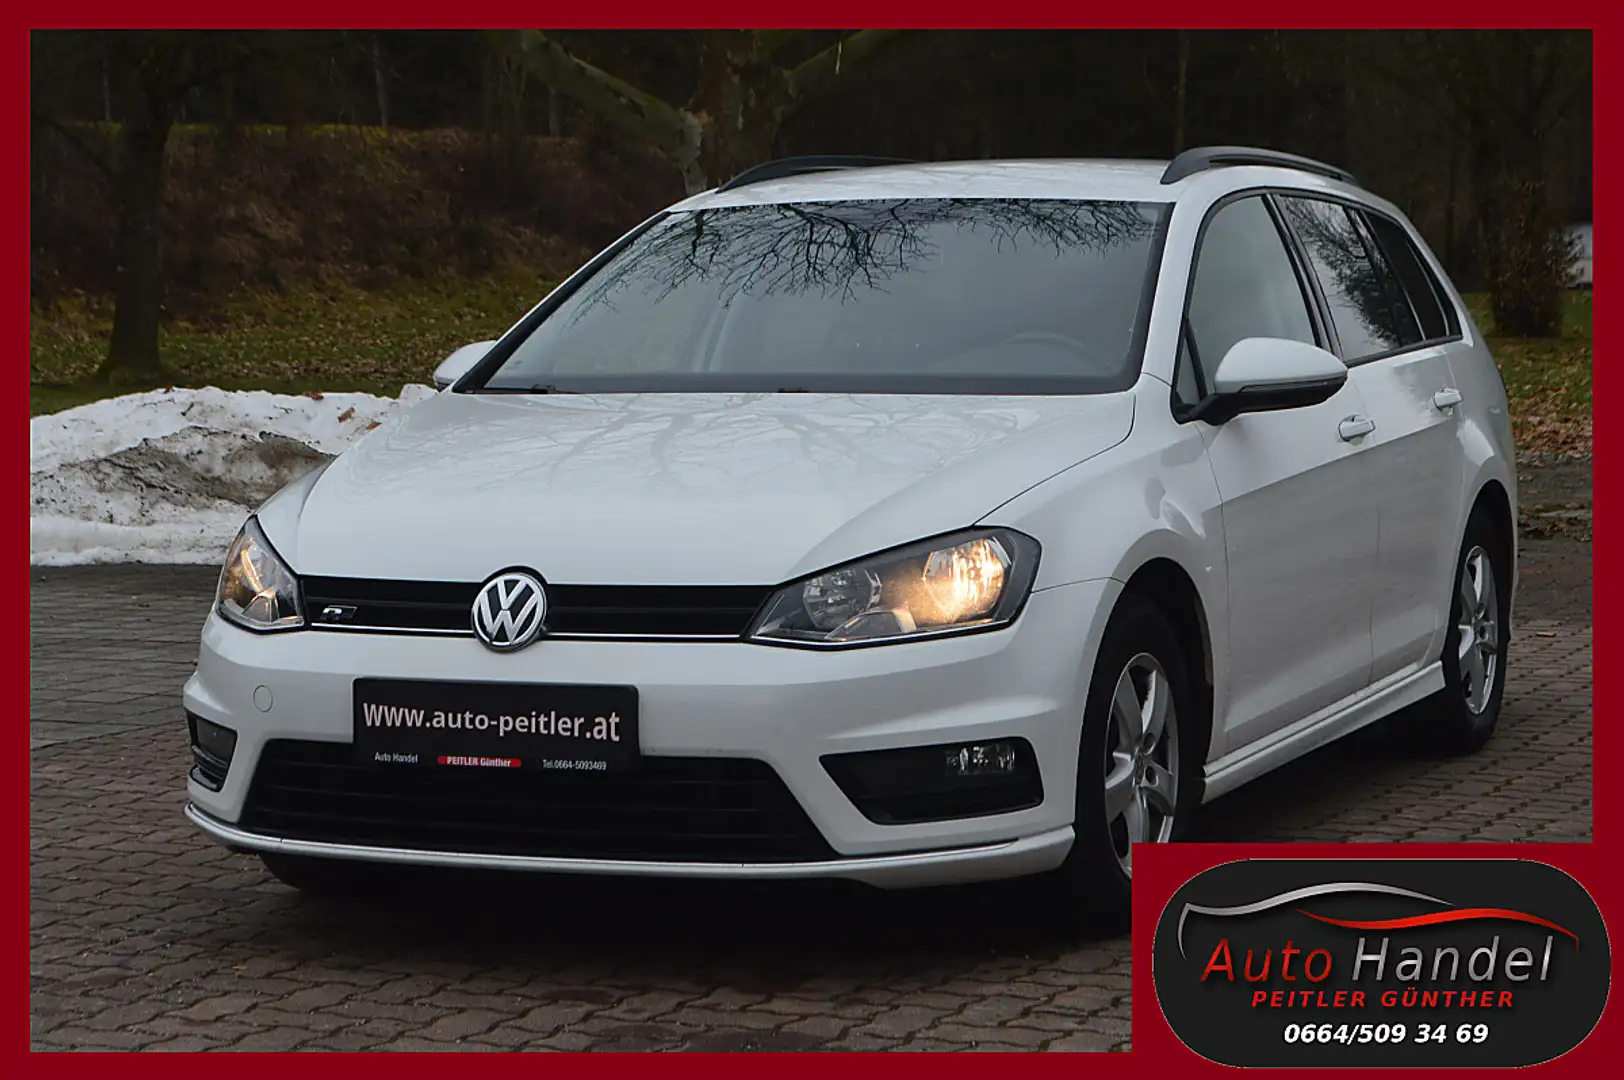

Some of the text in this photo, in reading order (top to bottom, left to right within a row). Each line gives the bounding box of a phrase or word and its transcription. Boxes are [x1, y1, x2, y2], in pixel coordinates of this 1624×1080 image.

[374, 751, 418, 764] Auto Handel
[446, 755, 479, 767] PEITLER
